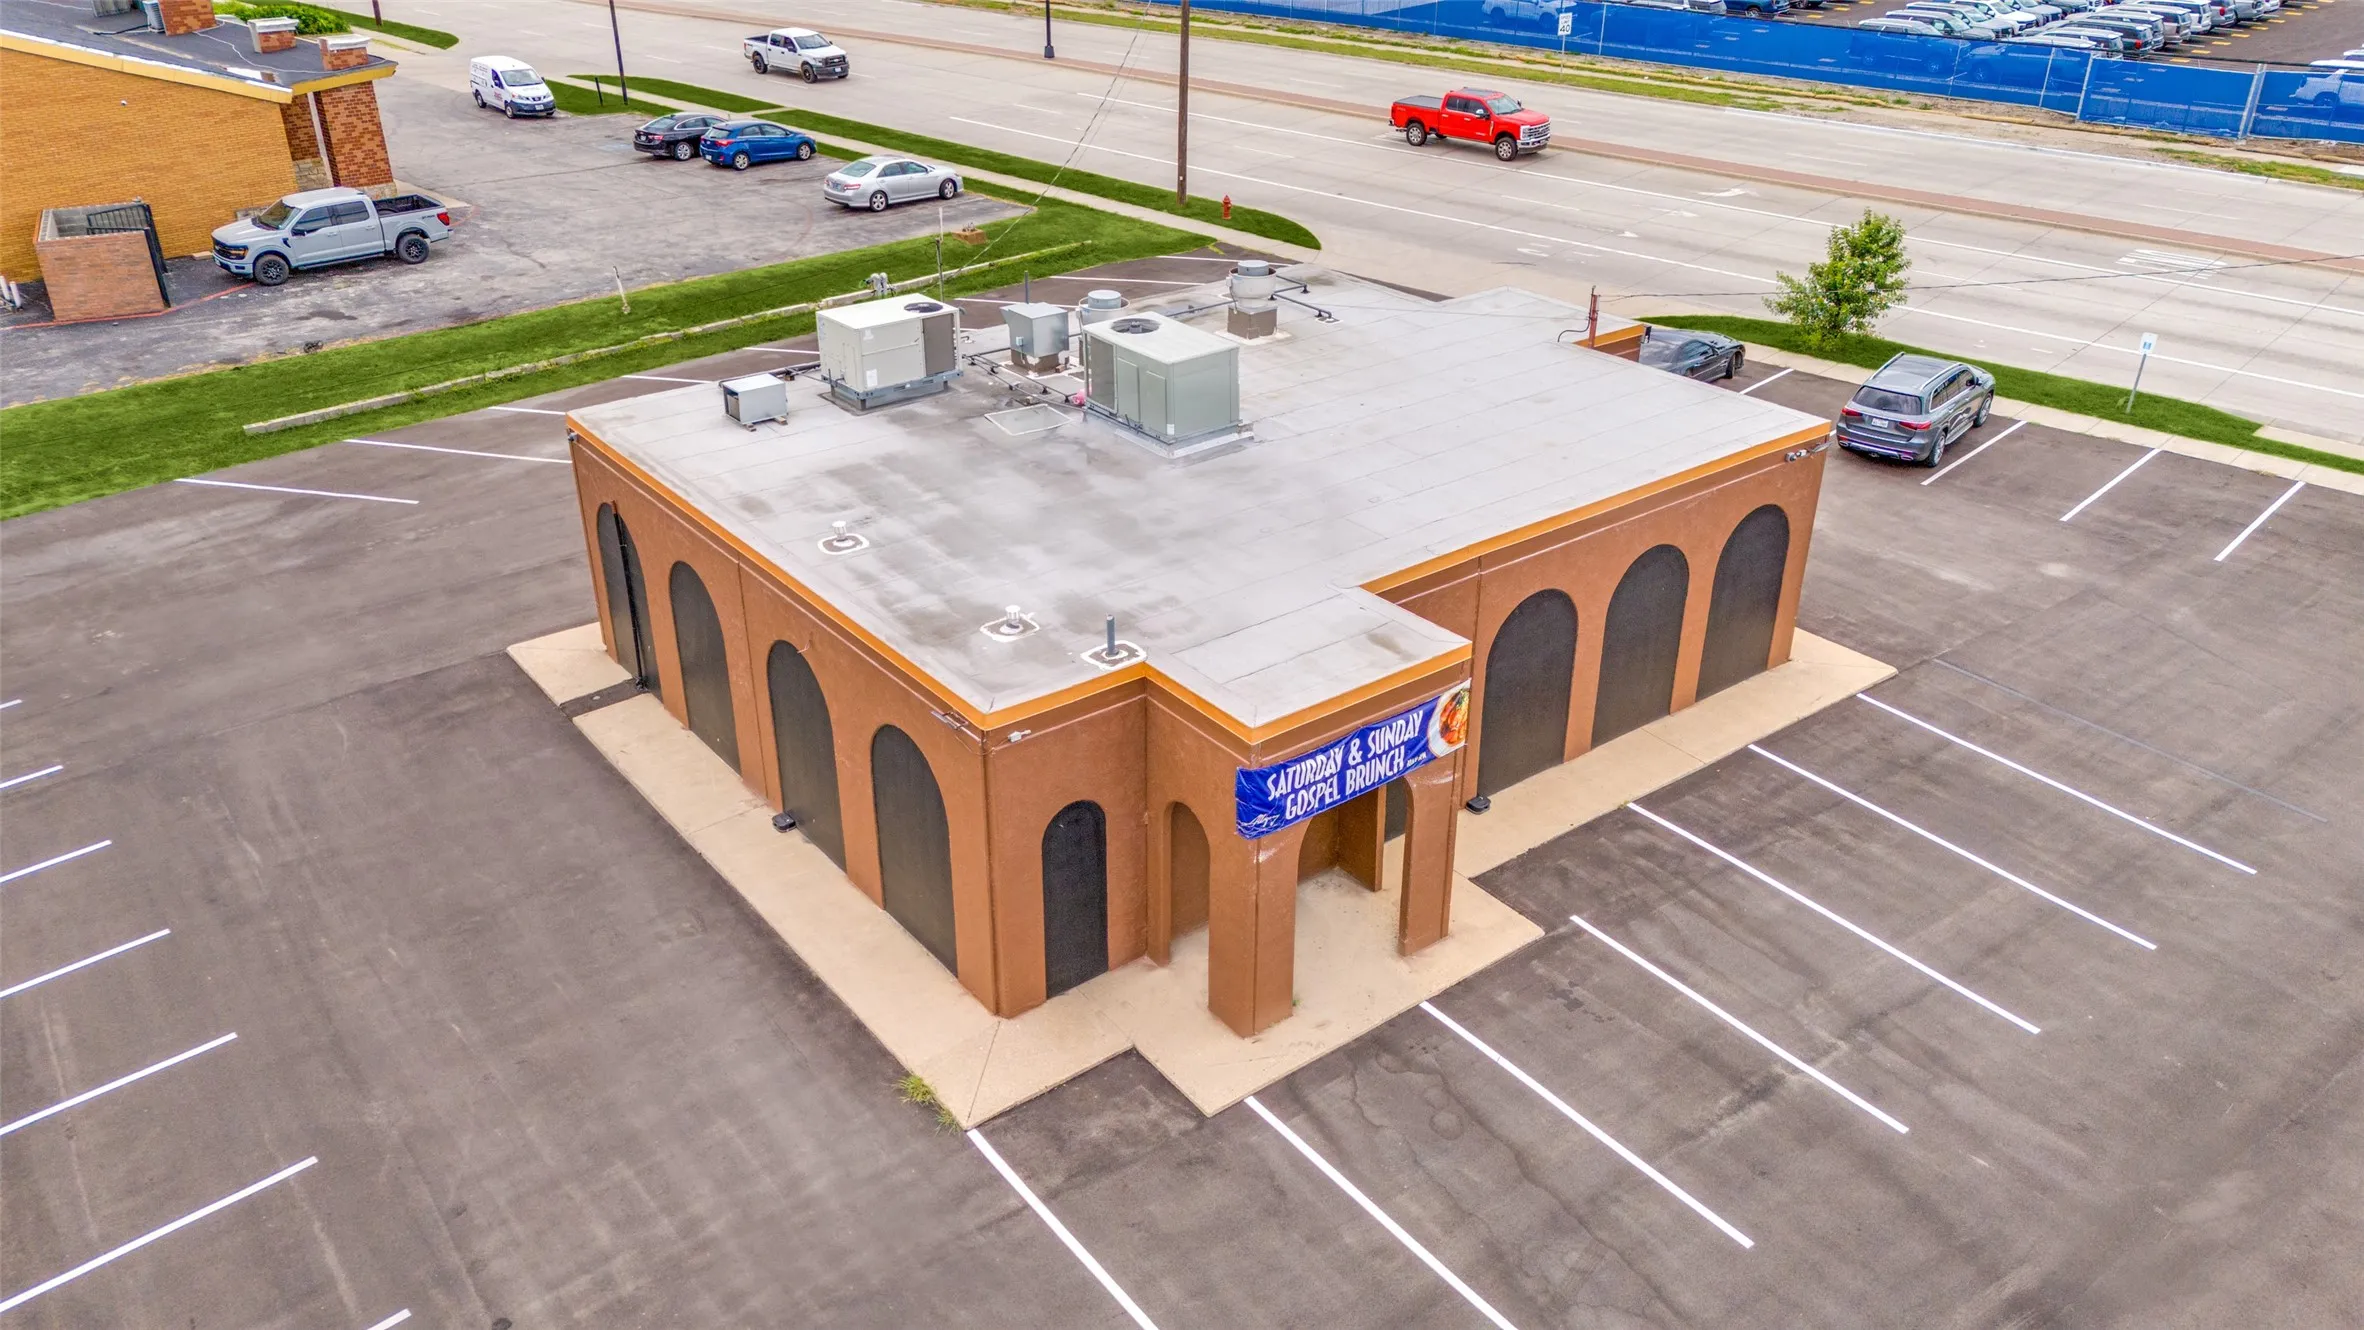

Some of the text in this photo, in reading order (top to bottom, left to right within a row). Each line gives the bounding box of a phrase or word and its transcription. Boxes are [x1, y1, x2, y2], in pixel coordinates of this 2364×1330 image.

[1560, 24, 1570, 32] 40
[1266, 710, 1423, 802] SATURDAY & SUNDAY
[1285, 745, 1405, 820] GOSPEL BRUNCH
